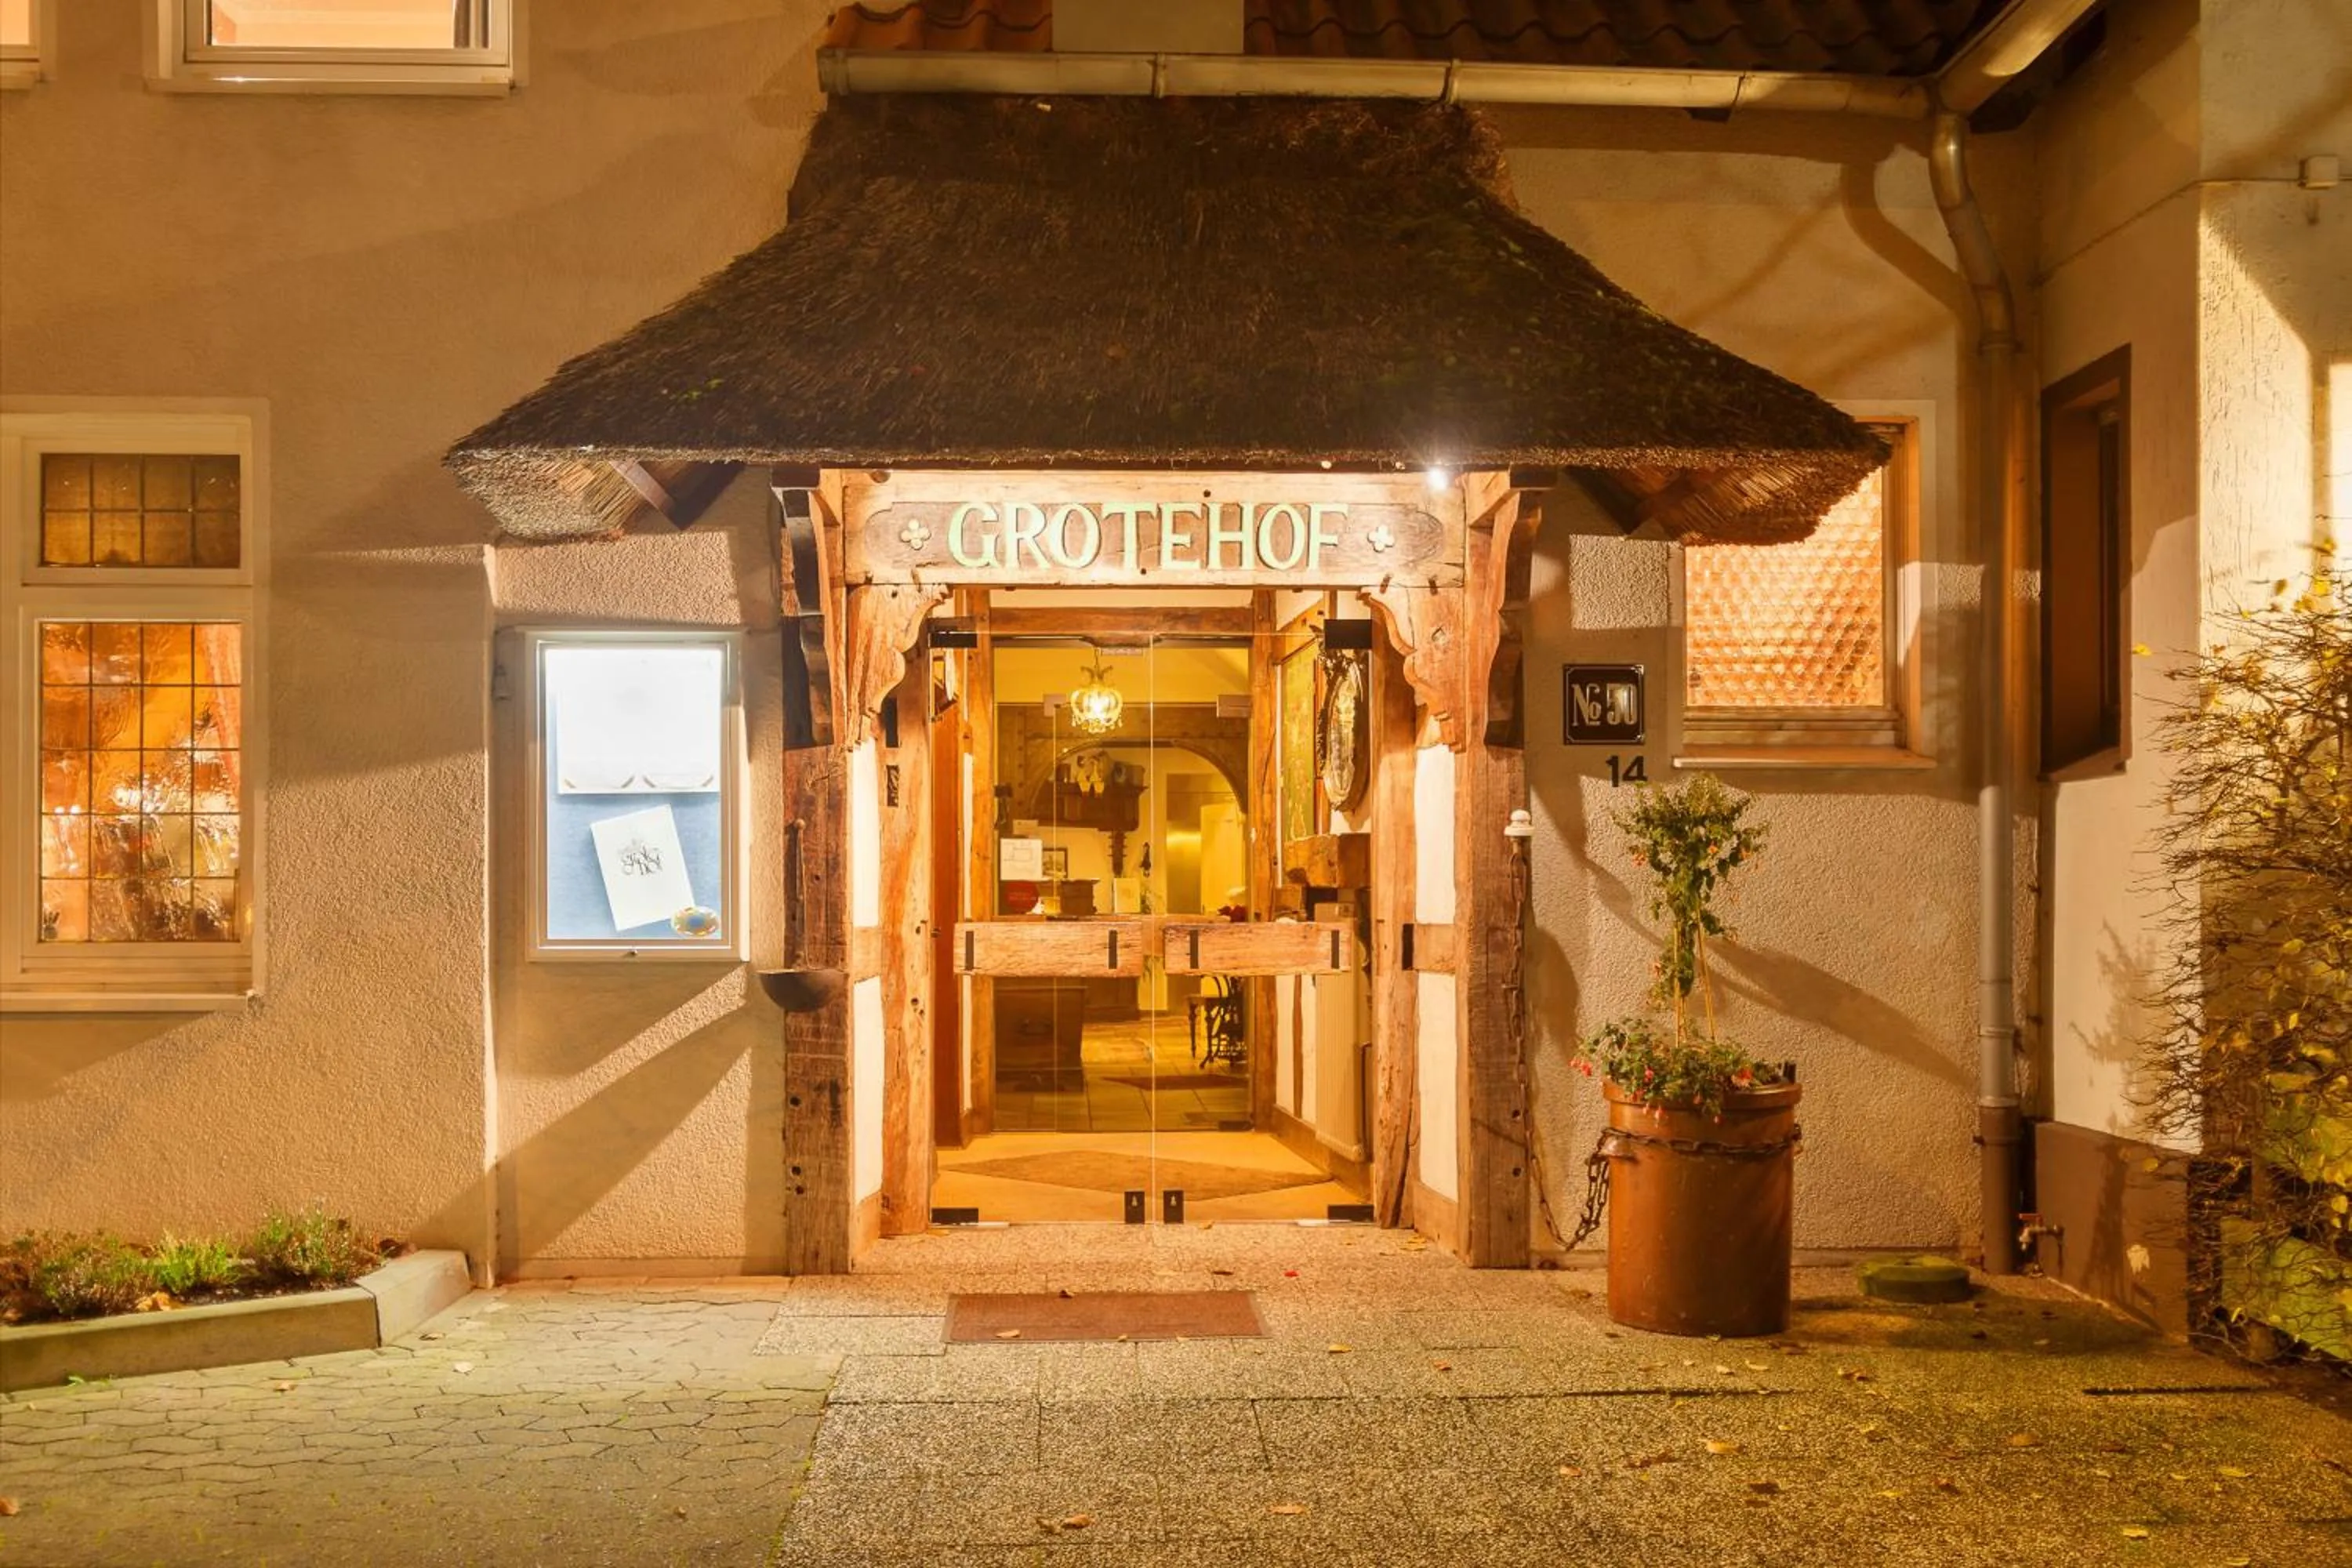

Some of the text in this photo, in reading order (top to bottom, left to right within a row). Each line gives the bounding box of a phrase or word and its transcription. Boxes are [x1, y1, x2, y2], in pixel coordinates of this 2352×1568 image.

[947, 502, 1348, 571] GROTEHOF
[1606, 683, 1639, 726] 50
[1606, 755, 1648, 788] 14
